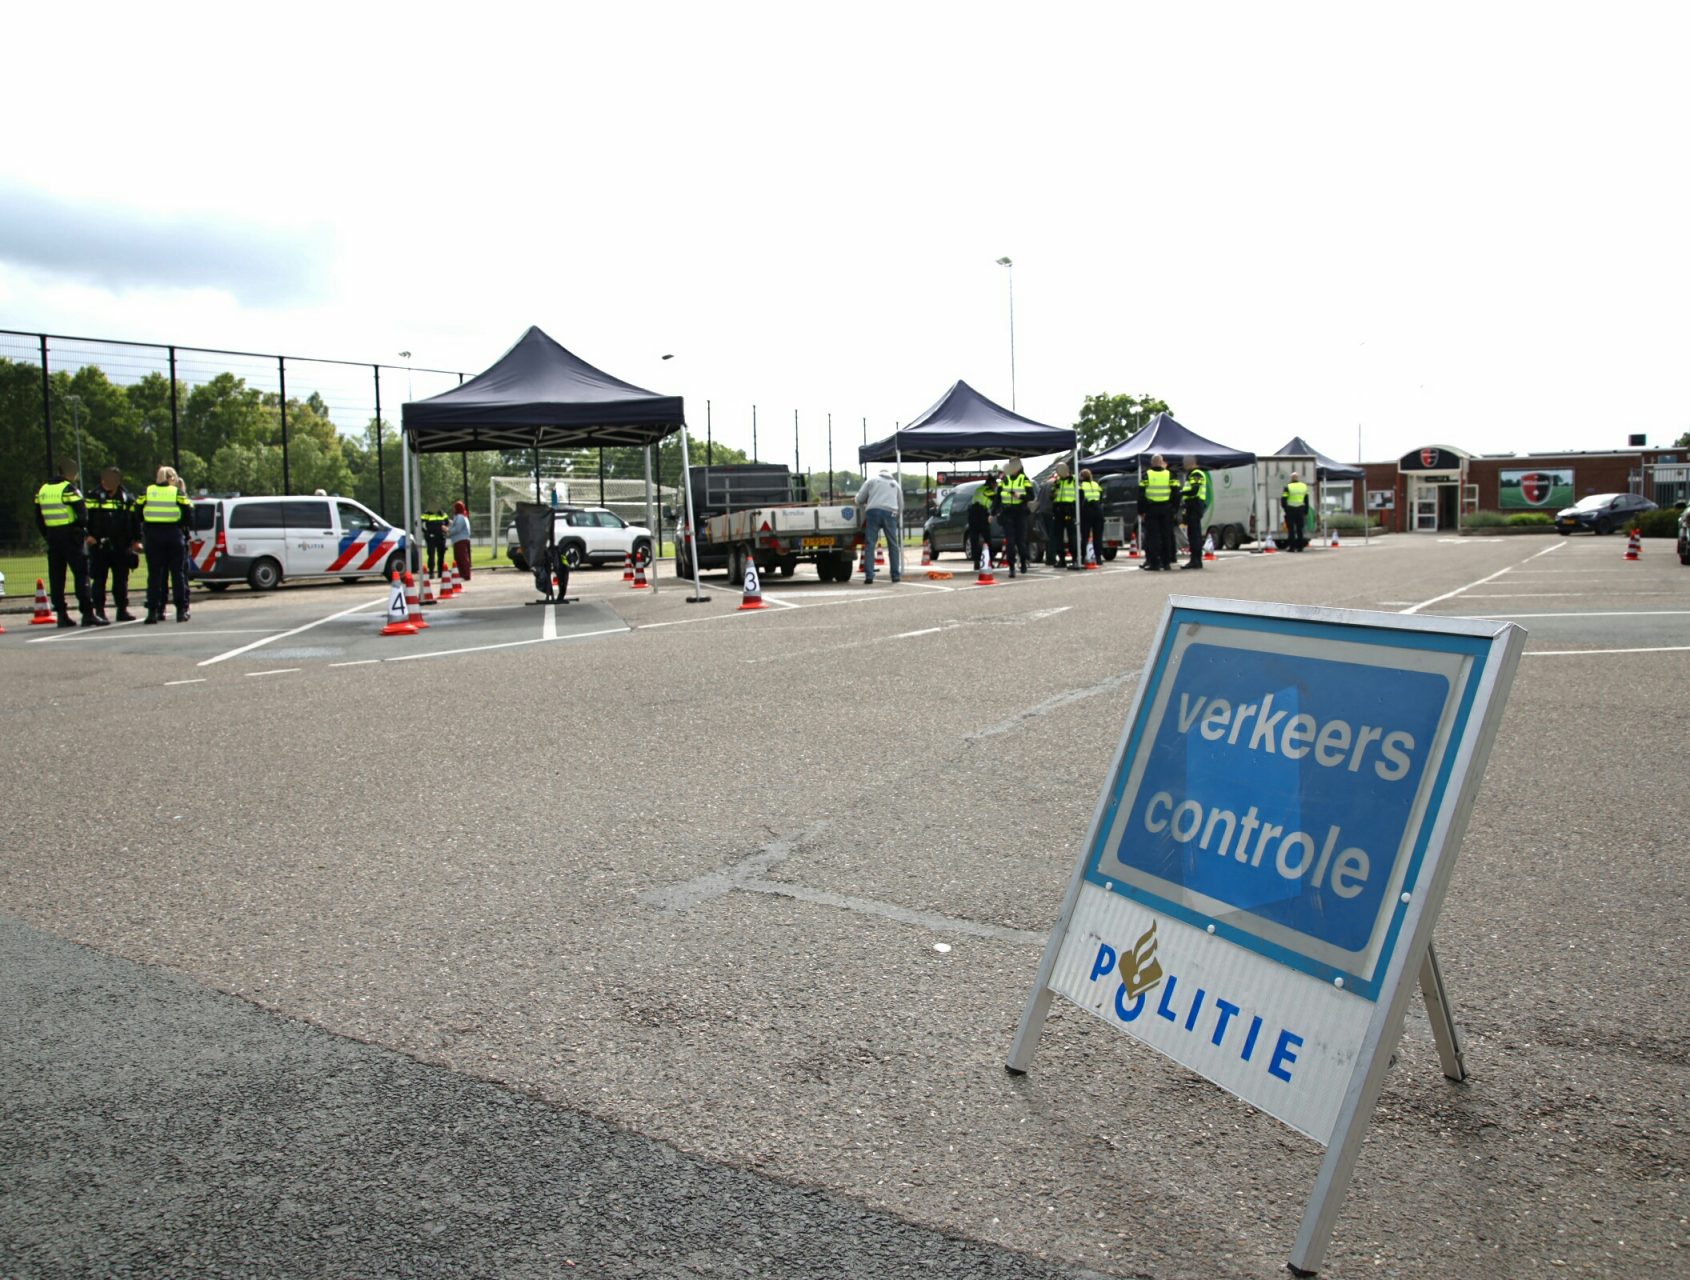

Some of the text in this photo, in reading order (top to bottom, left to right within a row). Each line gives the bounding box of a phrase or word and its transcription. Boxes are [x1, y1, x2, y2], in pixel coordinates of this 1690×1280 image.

[391, 591, 405, 615] 4
[745, 571, 757, 592] 3
[1177, 692, 1416, 782] verkeers
[1144, 791, 1370, 899] controle
[1090, 943, 1304, 1083] POLITIE
